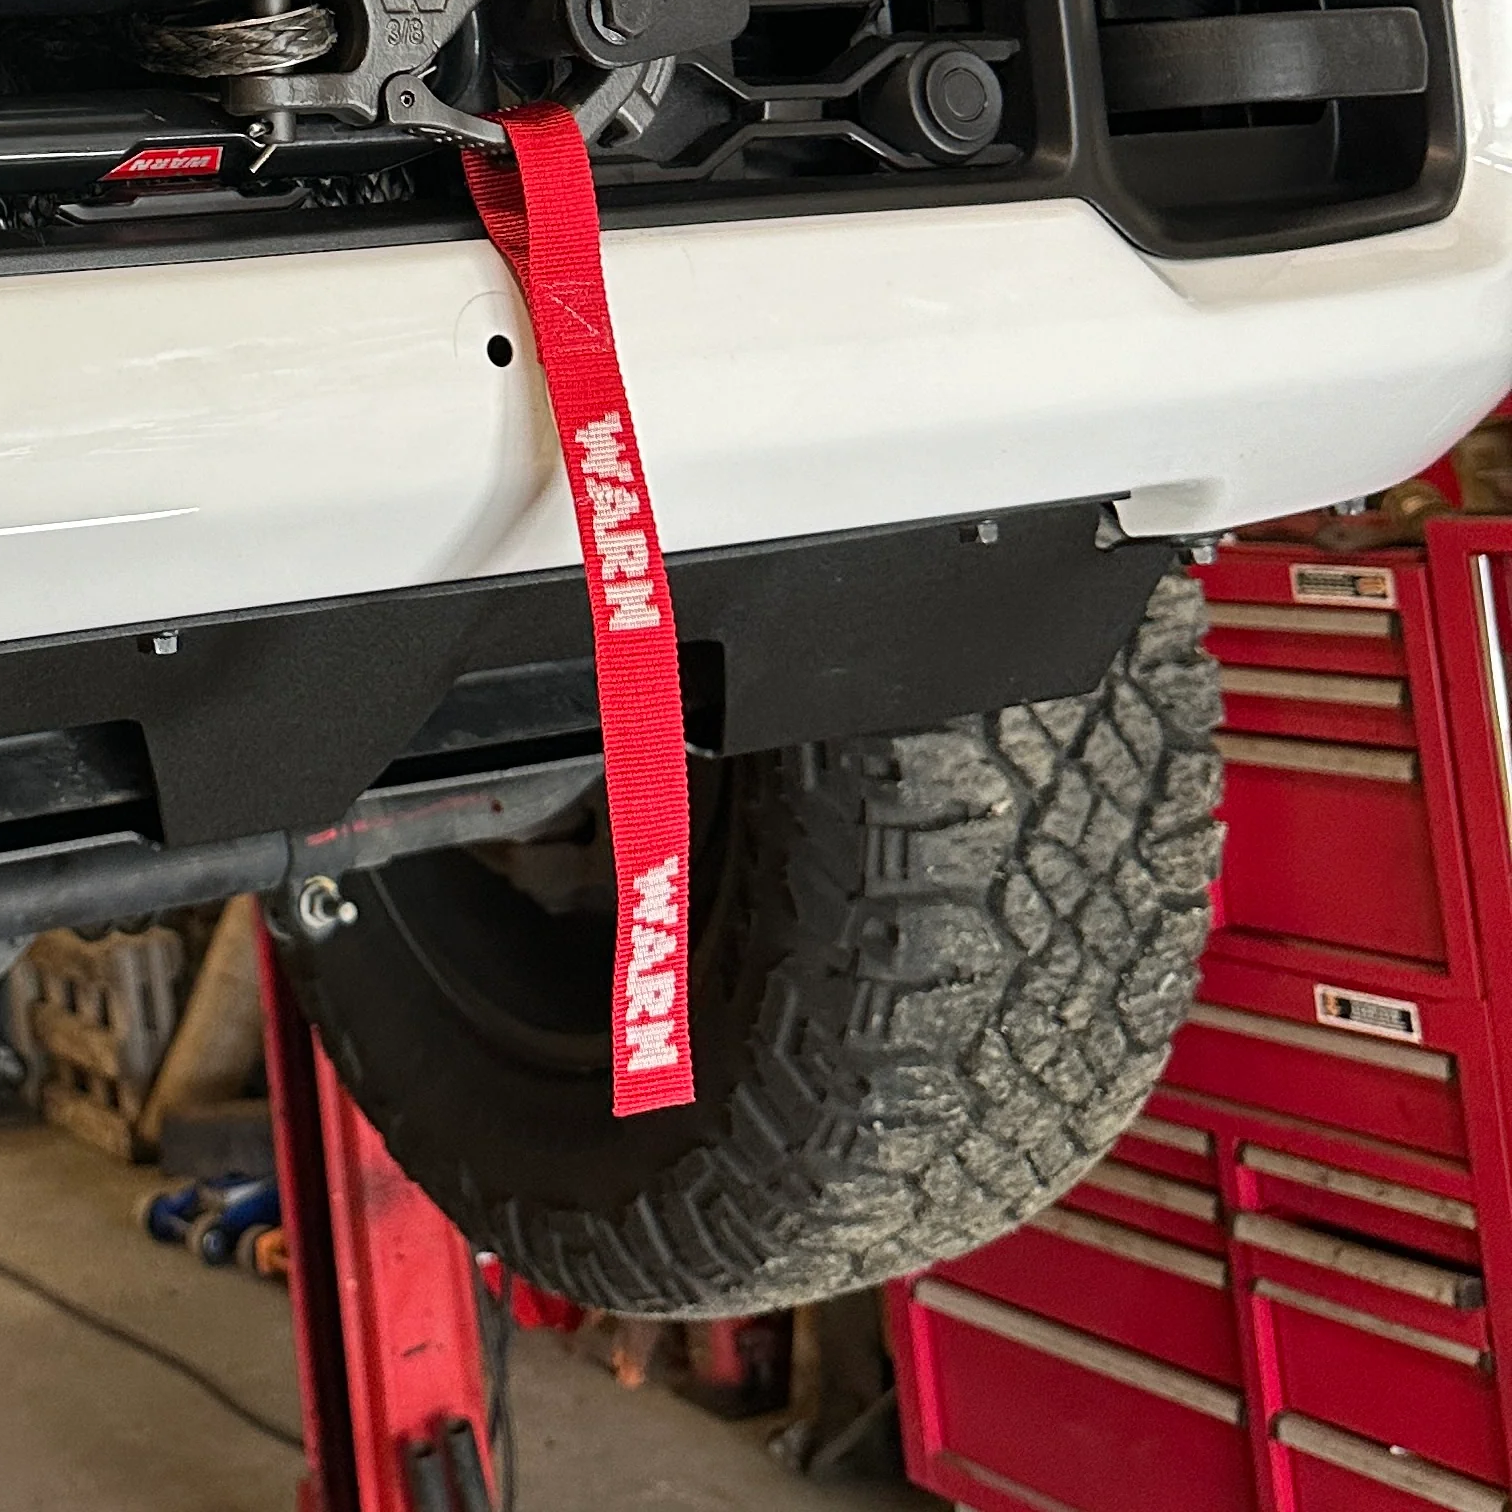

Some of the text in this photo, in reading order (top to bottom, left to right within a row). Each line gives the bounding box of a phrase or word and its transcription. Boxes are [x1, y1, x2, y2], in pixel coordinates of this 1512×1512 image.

[387, 18, 424, 46] 3/8
[128, 155, 212, 171] WARN
[575, 410, 661, 631] WARN
[625, 855, 679, 1072] WARN
